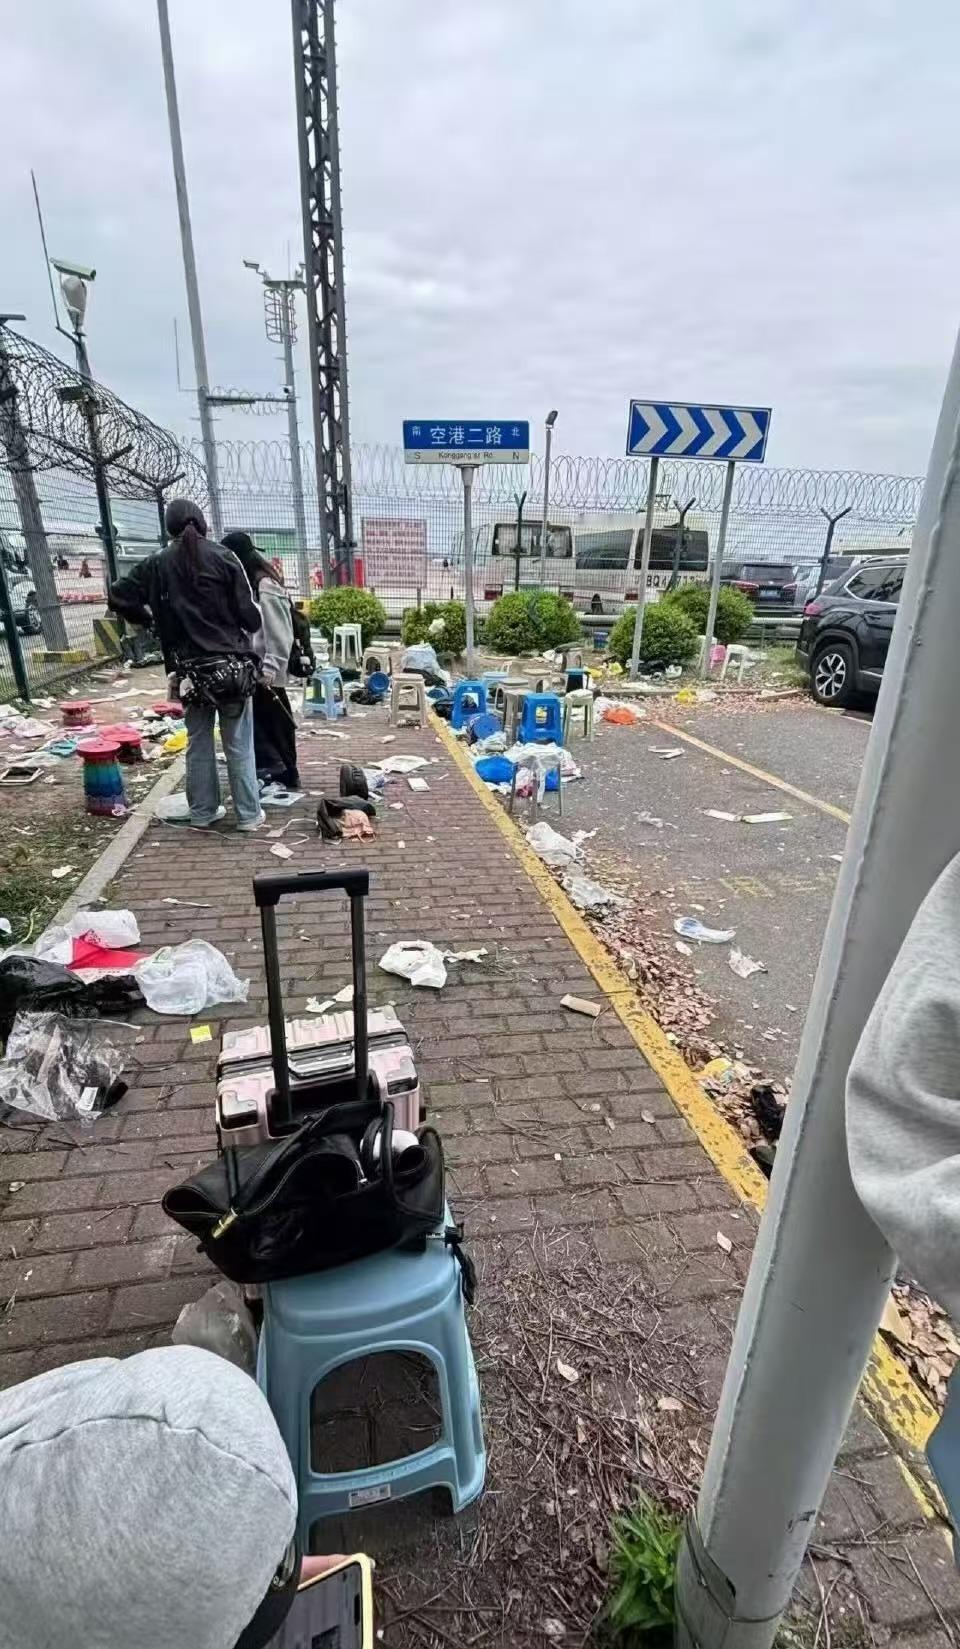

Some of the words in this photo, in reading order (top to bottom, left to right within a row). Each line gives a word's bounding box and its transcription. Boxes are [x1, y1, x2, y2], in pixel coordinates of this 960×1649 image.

[430, 425, 502, 445] 空港二路
[511, 425, 521, 437] 北
[415, 451, 421, 460] S
[512, 451, 520, 460] N
